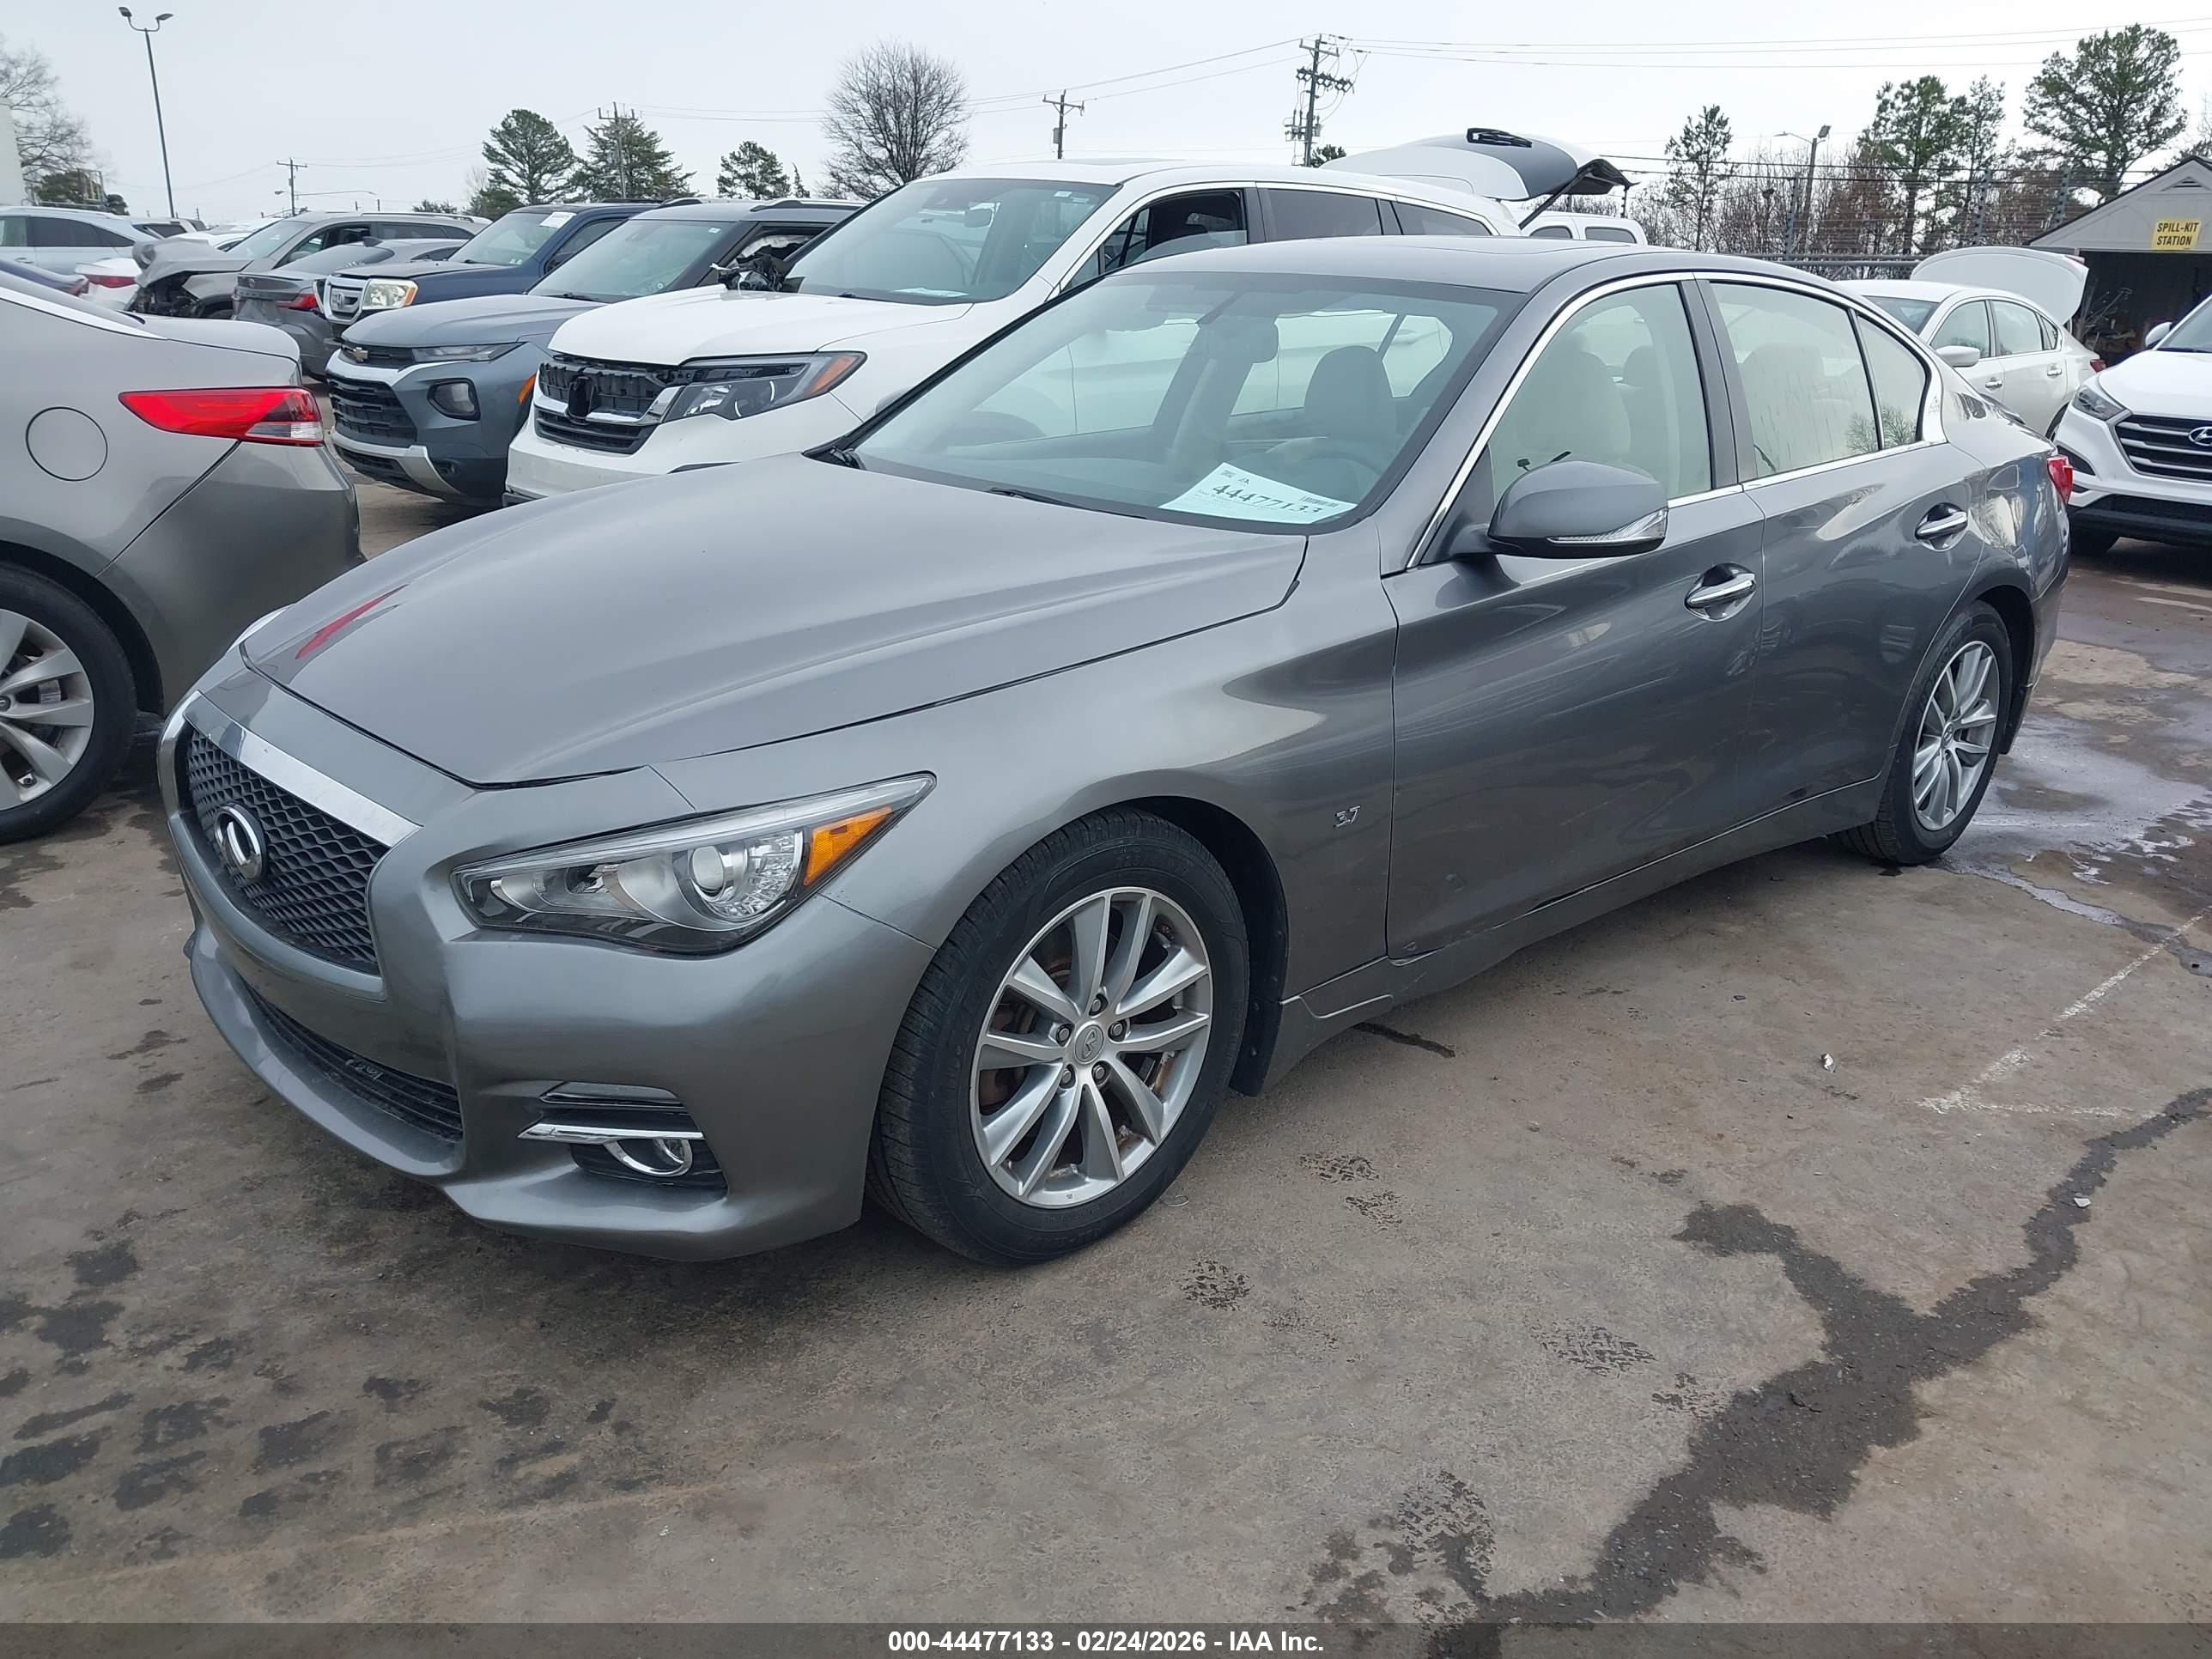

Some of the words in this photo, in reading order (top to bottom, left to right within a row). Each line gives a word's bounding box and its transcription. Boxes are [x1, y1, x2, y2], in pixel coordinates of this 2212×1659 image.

[2157, 222, 2199, 233] SPILL-KIT
[2156, 235, 2192, 246] STATION
[1212, 484, 1322, 513] 44477133
